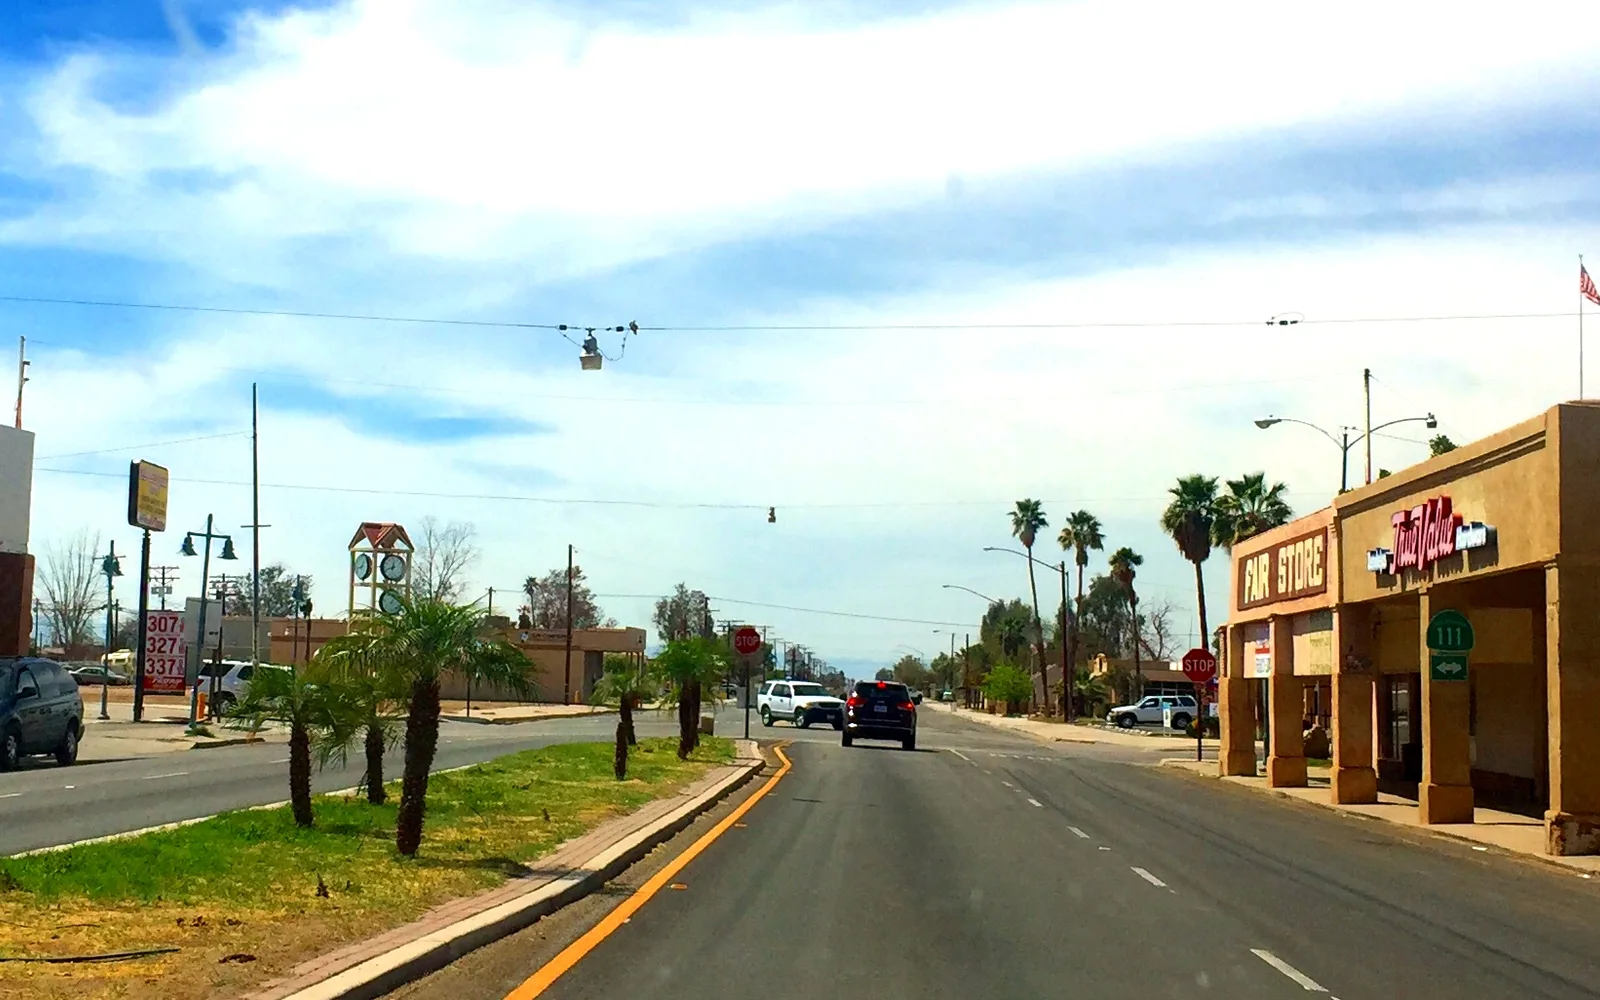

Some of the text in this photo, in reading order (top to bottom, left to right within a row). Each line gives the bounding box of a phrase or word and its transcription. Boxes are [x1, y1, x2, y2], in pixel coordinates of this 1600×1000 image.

[1411, 496, 1454, 570] Value
[1244, 552, 1270, 604] FAIR
[1278, 535, 1323, 594] STORE
[147, 615, 179, 633] 307
[146, 636, 178, 654] 327
[736, 636, 758, 646] STOP
[1437, 627, 1461, 645] 111
[145, 657, 177, 675] 337
[1184, 659, 1215, 672] STOP
